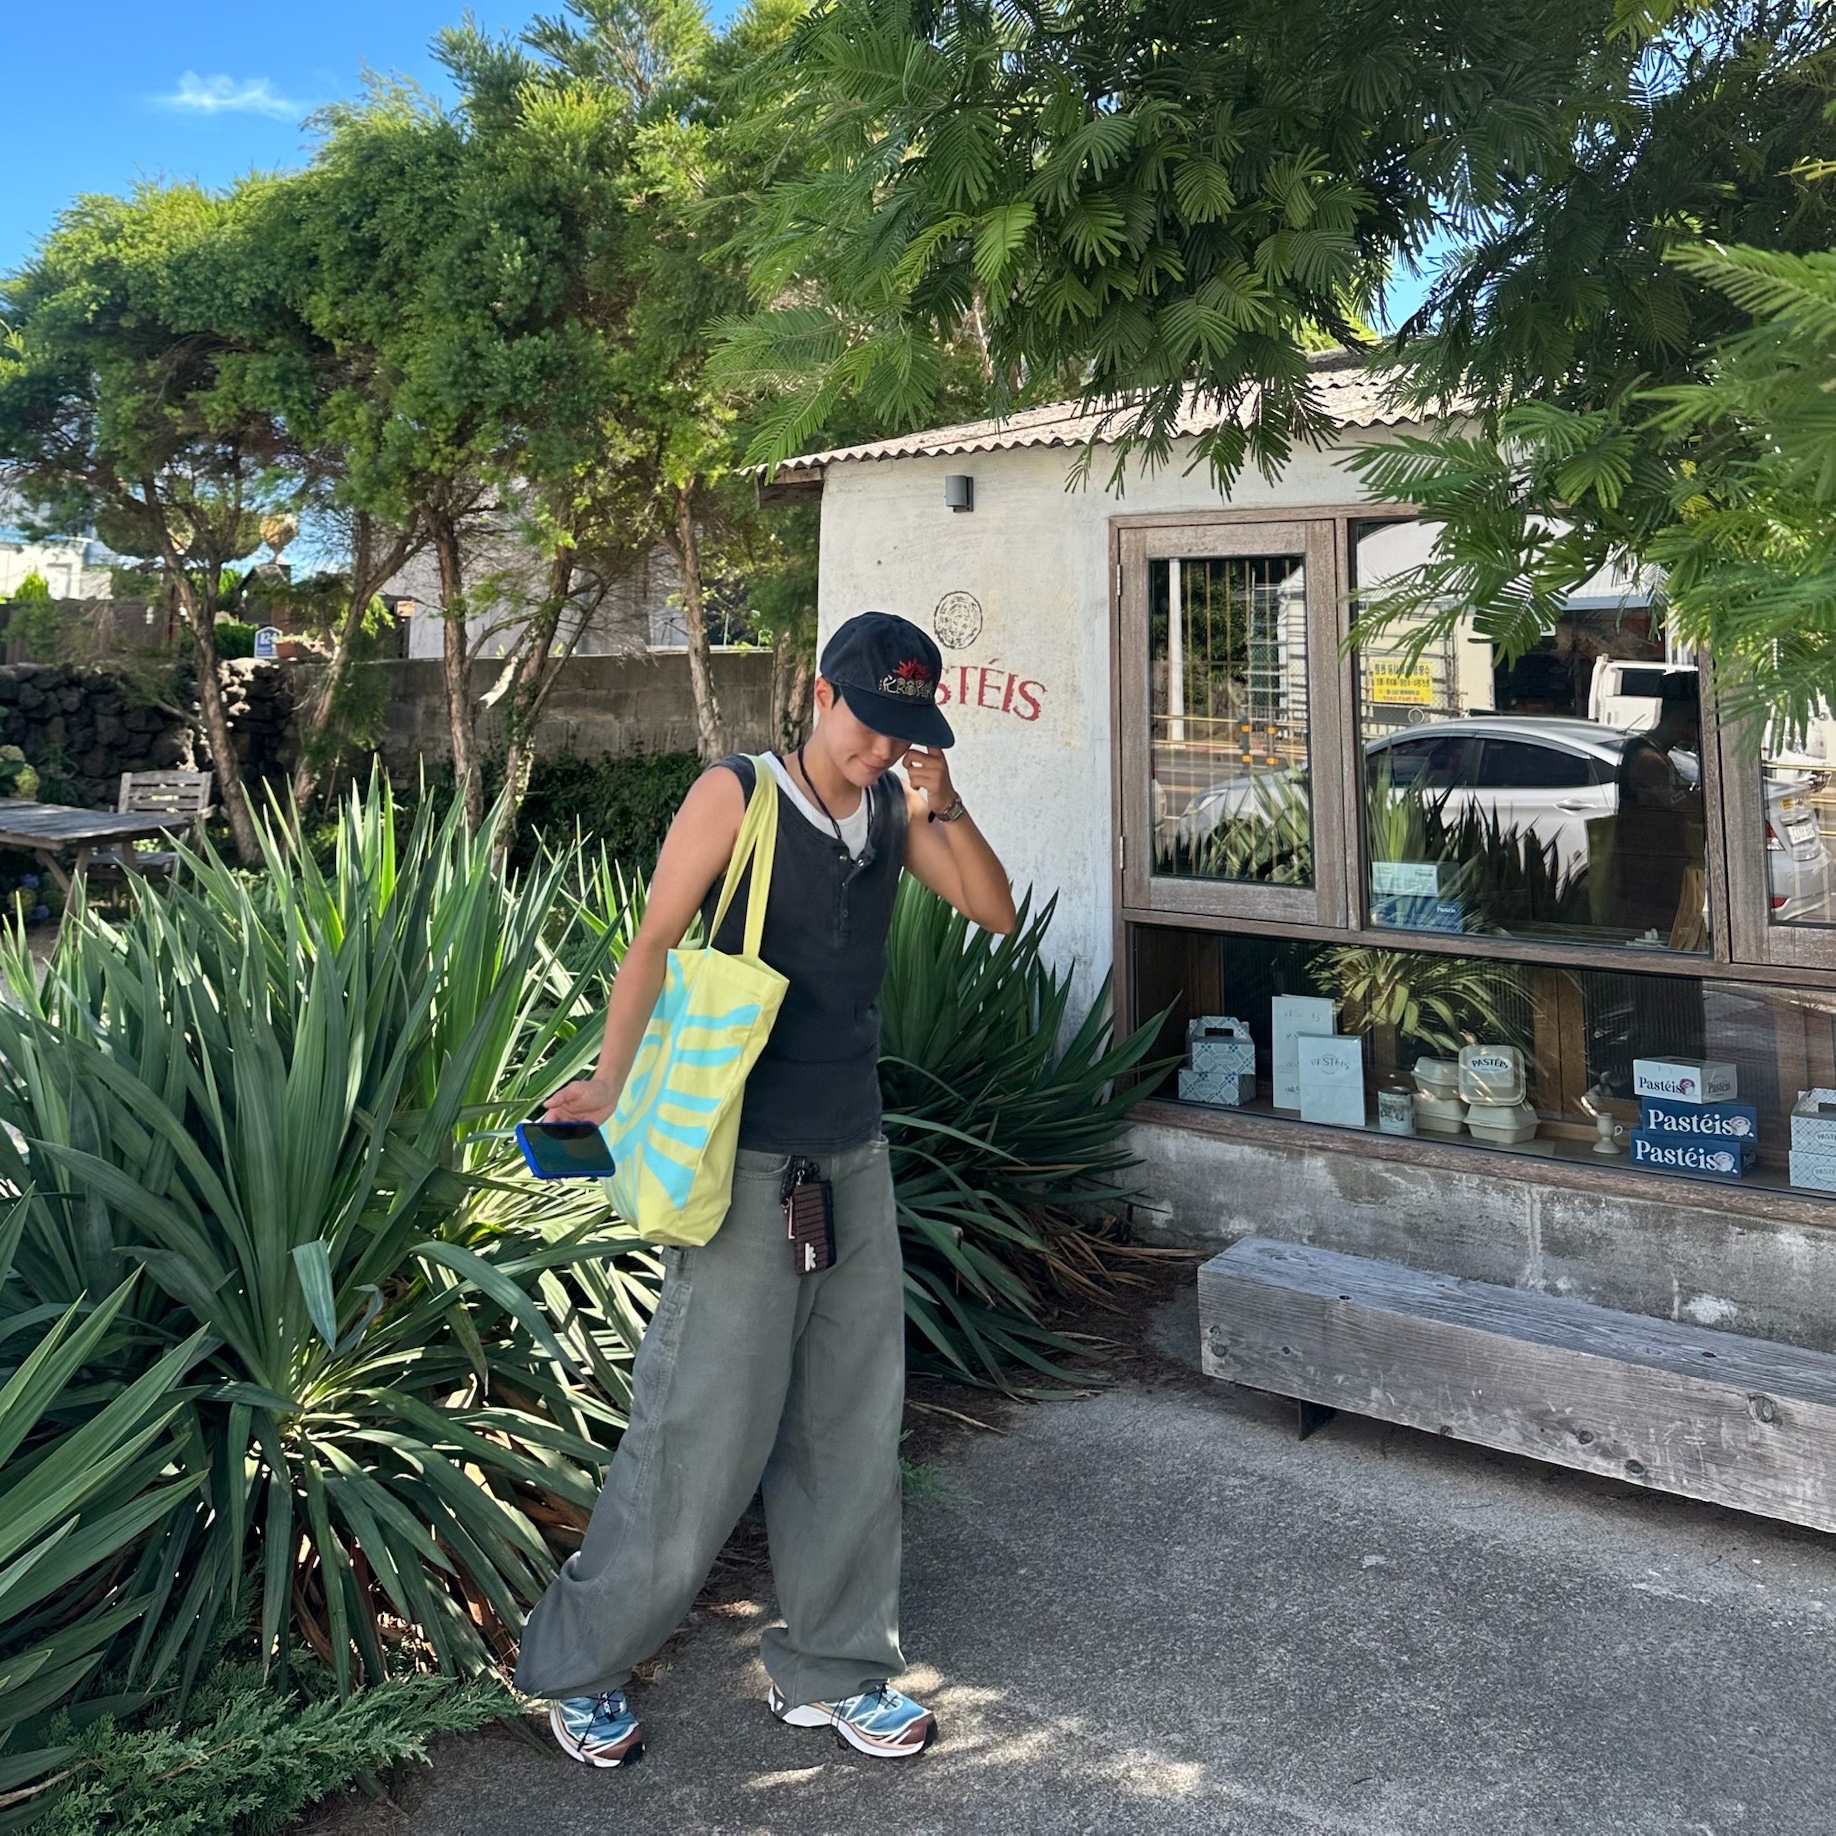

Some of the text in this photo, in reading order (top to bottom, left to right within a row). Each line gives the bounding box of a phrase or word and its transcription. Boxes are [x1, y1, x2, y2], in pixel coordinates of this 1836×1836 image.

[935, 658, 1047, 721] STÉIS
[1471, 1058, 1508, 1069] PASTÉIS
[1639, 1076, 1684, 1094] Pastéis
[1648, 1109, 1734, 1136] Pastéis
[1635, 1139, 1717, 1171] Pastéis
